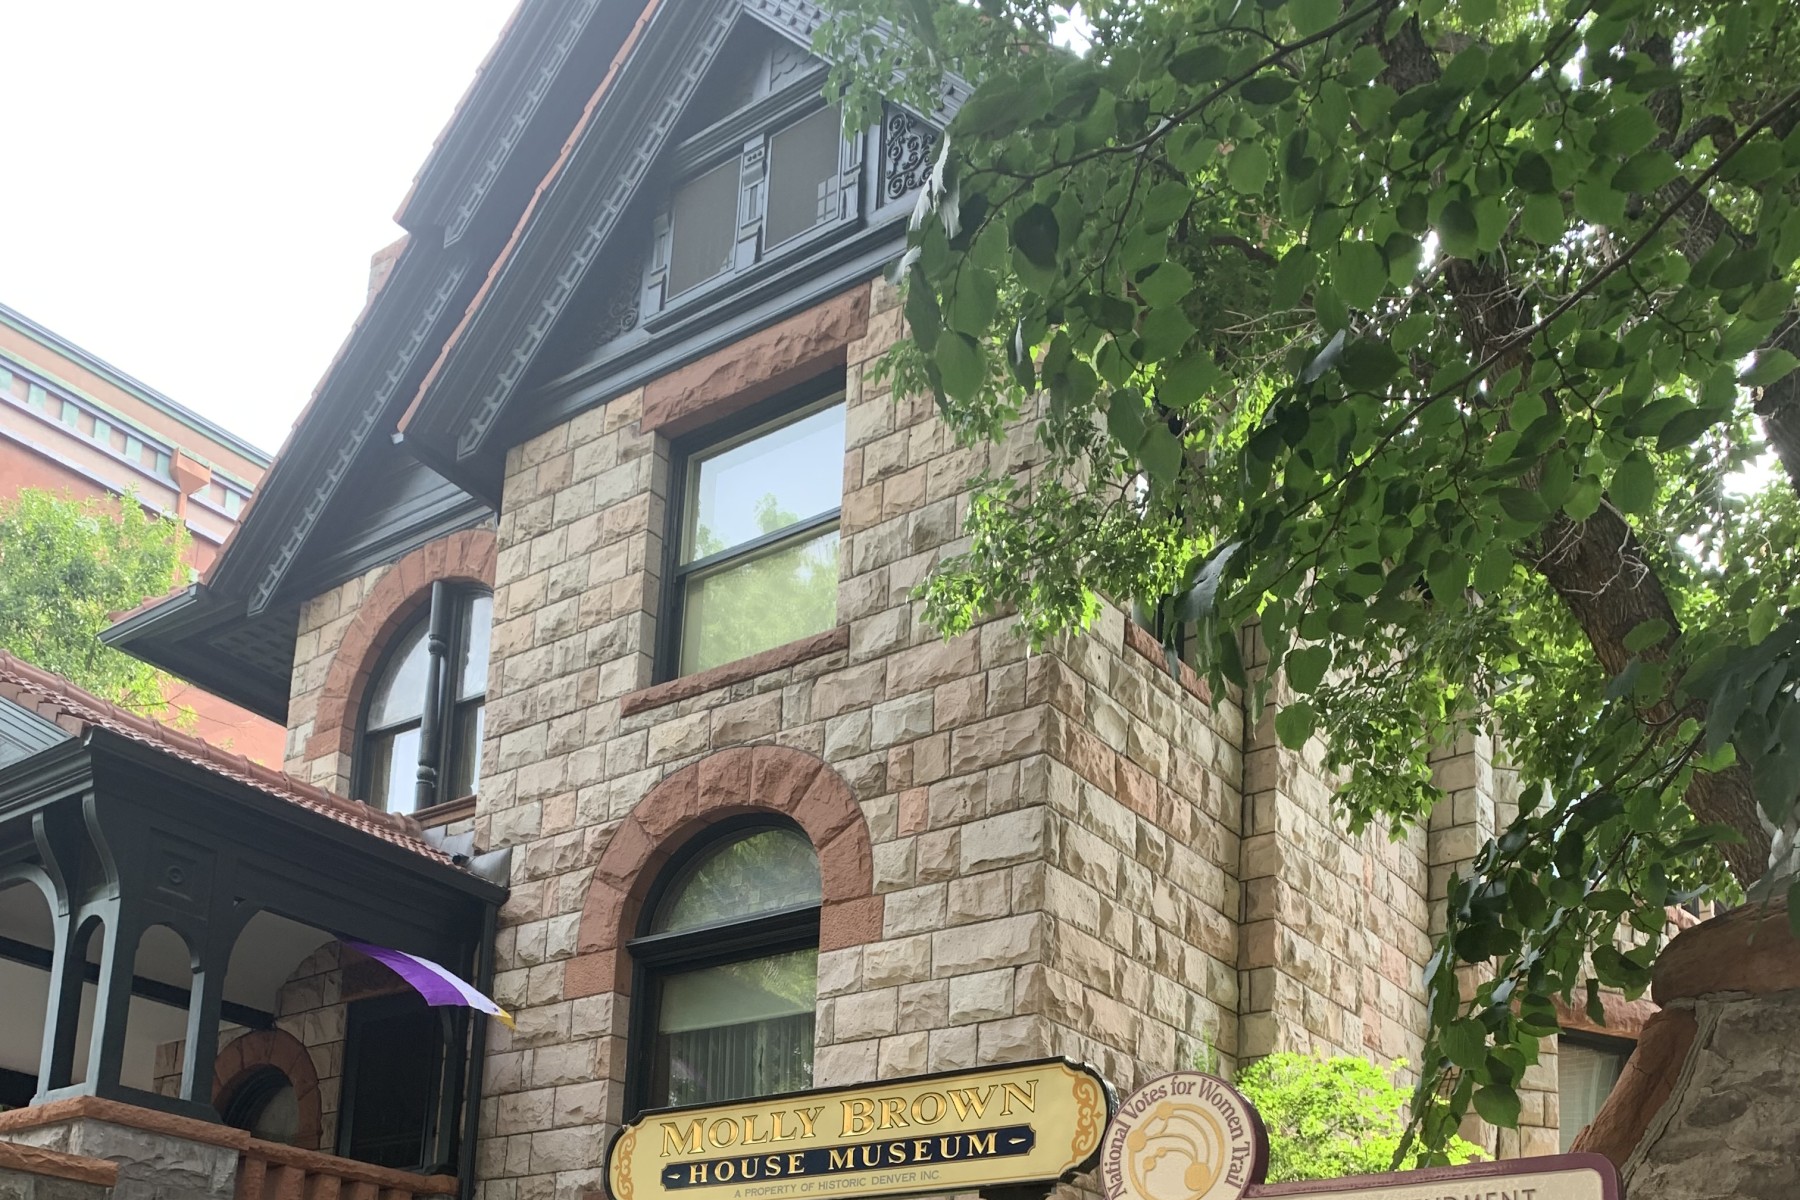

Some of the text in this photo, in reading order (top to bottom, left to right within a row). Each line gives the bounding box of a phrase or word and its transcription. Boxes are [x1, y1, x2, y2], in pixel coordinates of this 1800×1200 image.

[660, 1080, 1039, 1158] MOLLY BROWN
[1104, 1076, 1251, 1200] National Votes for Women Trail
[687, 1132, 999, 1185] HOUSE MUSEUM
[734, 1170, 942, 1198] A PROPERTY OF HISTORIC DENVER INC.
